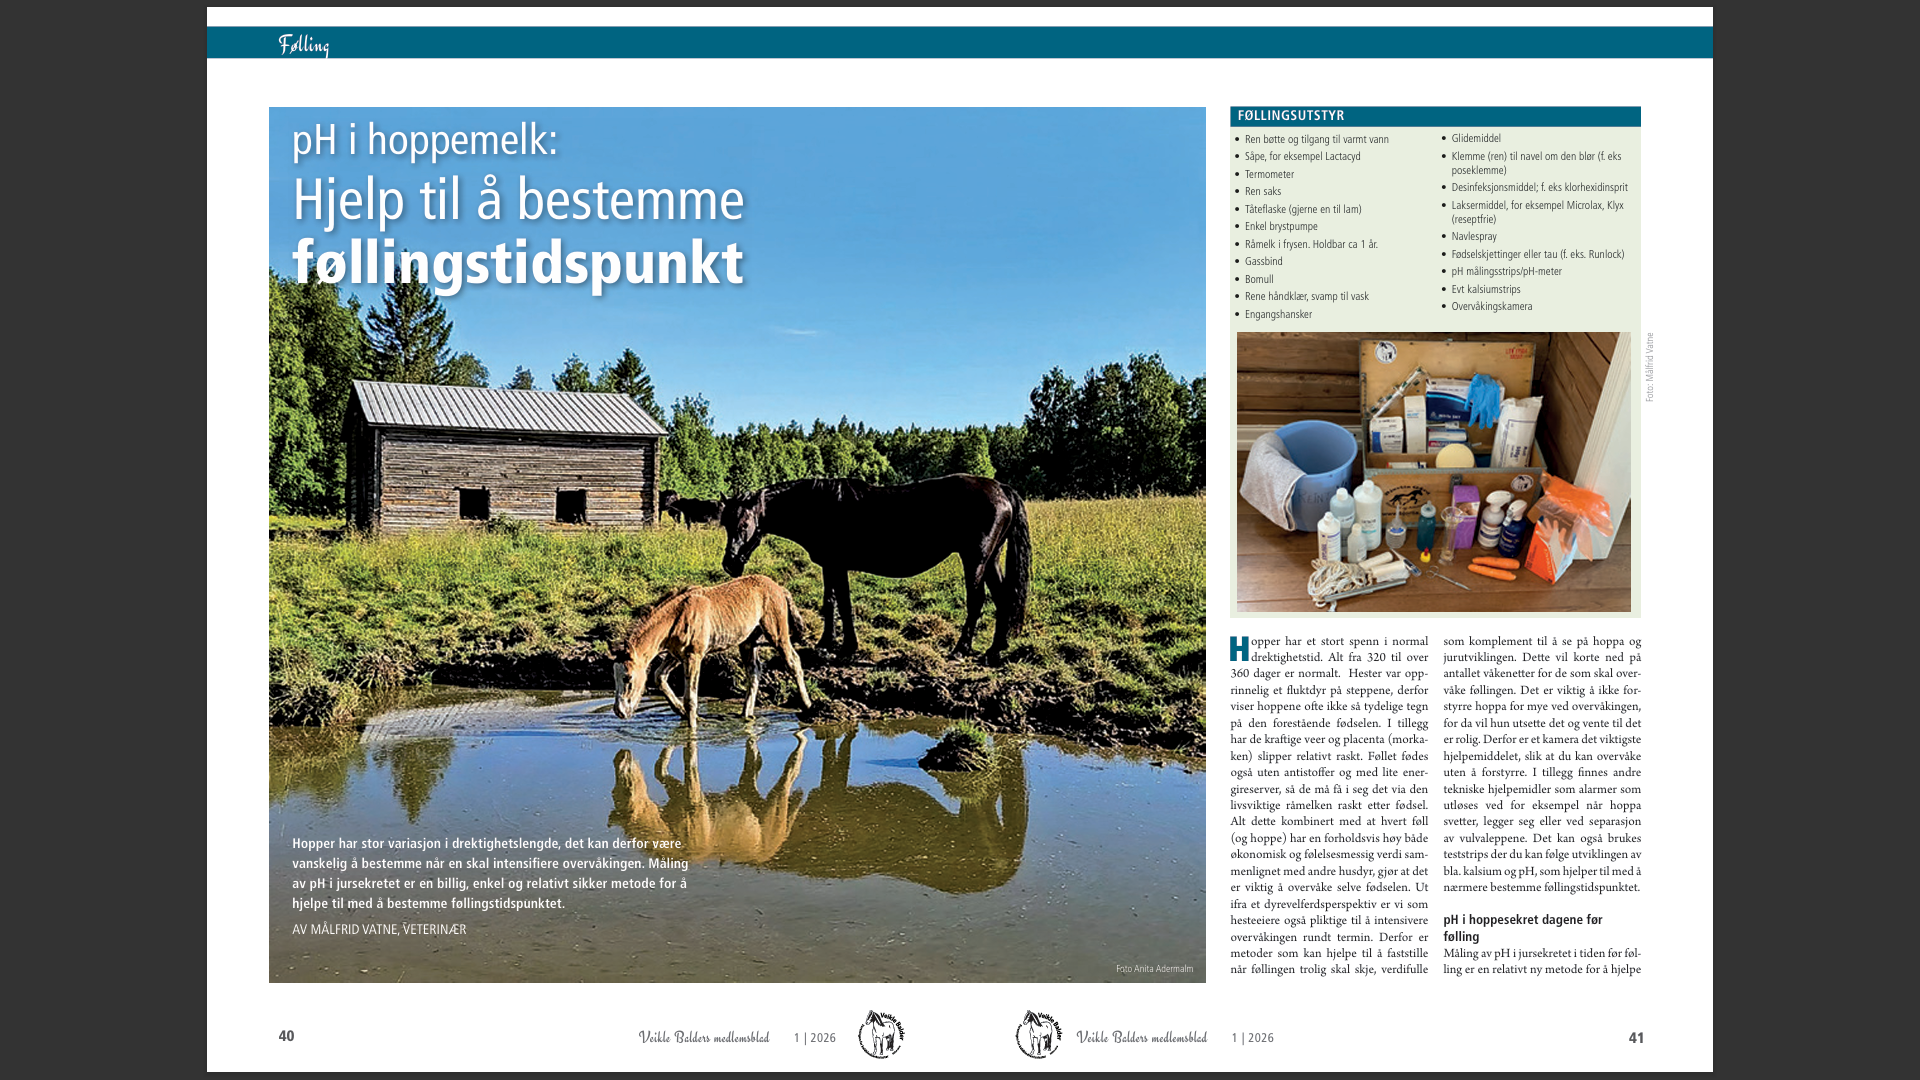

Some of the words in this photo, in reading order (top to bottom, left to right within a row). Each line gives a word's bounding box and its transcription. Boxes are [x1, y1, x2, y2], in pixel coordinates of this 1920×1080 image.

[279, 34, 329, 58] Følling
[1238, 110, 1344, 121] FØLLINGSUTSTYR
[294, 124, 334, 163] pH
[370, 122, 555, 163] hoppemelk:
[1452, 133, 1501, 142] Glidemiddel
[1245, 151, 1266, 163] Såpe,
[1270, 151, 1281, 160] for
[1284, 151, 1322, 162] eksempel
[1326, 151, 1360, 163] Lactacyd
[1245, 170, 1294, 178] Termometer
[1452, 165, 1506, 177] poseklemme)
[1246, 187, 1260, 195] Ren
[1264, 186, 1281, 195] saks
[1452, 182, 1538, 194] Desinfeksjonsmiddel;
[1541, 182, 1545, 191] f.
[1548, 182, 1562, 191] eks
[1565, 182, 1628, 193] klorhexidinsprit
[297, 176, 403, 232] Hjelp
[420, 176, 458, 219] til
[478, 174, 499, 219] å
[520, 176, 743, 219] bestemme
[1452, 200, 1508, 211] Laksermiddel,
[1511, 200, 1522, 209] for
[1525, 200, 1564, 212] eksempel
[1567, 200, 1604, 211] Microlax,
[1608, 200, 1624, 212] Klyx
[1452, 214, 1496, 226] (reseptfrie)
[1246, 221, 1266, 230] Enkel
[1270, 221, 1318, 233] brystpumpe
[1452, 231, 1497, 243] Navlespray
[293, 238, 742, 296] føllingstidspunkt
[1245, 256, 1282, 265] Gassbind
[1246, 274, 1273, 283] Bomull
[1452, 267, 1463, 278] pH
[1467, 266, 1562, 278] målingsstrips/pH-meter
[1452, 285, 1464, 293] Evt
[1468, 284, 1521, 296] kalsiumstrips
[1246, 292, 1265, 300] Rene
[1269, 291, 1308, 301] håndklær,
[1311, 294, 1338, 303] svamp
[1351, 291, 1369, 300] vask
[1452, 301, 1532, 313] Overvåkingskamera
[1246, 309, 1312, 321] Engangshansker
[1645, 332, 1654, 354] Vatne
[1645, 356, 1654, 382] Målfrid
[1645, 384, 1654, 402] Foto:
[1251, 652, 1323, 665] drektighetstid.
[1328, 652, 1343, 661] Alt
[1349, 652, 1362, 661] fra
[1367, 653, 1386, 662] 320
[1391, 652, 1401, 661] til
[1443, 652, 1516, 665] jurutviklingen.
[1523, 652, 1550, 661] Dette
[1556, 652, 1568, 661] vil
[1574, 652, 1599, 661] korte
[1606, 652, 1624, 661] ned
[1630, 653, 1641, 665] på
[1444, 784, 1484, 793] tekniske
[1488, 784, 1551, 797] hjelpemidler
[1579, 784, 1617, 793] alarmer
[1231, 800, 1280, 813] livsviktige
[1286, 800, 1332, 809] råmelken
[1338, 800, 1362, 809] raskt
[1396, 800, 1428, 809] fødsel.
[293, 838, 335, 851] Hopper
[340, 838, 357, 848] har
[362, 839, 384, 848] stor
[388, 838, 440, 851] variasjon
[453, 838, 560, 851] drektighetslengde,
[565, 838, 584, 848] det
[588, 838, 608, 848] kan
[613, 838, 648, 848] derfor
[1460, 833, 1527, 846] vulvaleppene.
[1533, 833, 1552, 842] Det
[1557, 833, 1575, 842] kan
[1581, 834, 1603, 846] også
[1608, 833, 1641, 842] brukes
[1231, 849, 1286, 858] økonomisk
[1289, 852, 1301, 862] og
[1305, 849, 1374, 862] følelsesmessig
[1377, 849, 1402, 858] verdi
[1490, 882, 1541, 891] bestemme
[1545, 882, 1640, 895] føllingstidspunktet.
[293, 898, 327, 911] hjelpe
[332, 898, 343, 908] til
[348, 898, 372, 908] med
[377, 898, 383, 908] å
[388, 898, 447, 908] bestemme
[452, 898, 564, 911] føllingstidspunktet.
[1231, 899, 1247, 908] ifra
[1264, 899, 1377, 912] dyrevelferdsperspektiv
[1394, 900, 1403, 908] vi
[1444, 914, 1458, 927] pH
[1469, 914, 1538, 927] hoppesekret
[1542, 914, 1583, 927] dagene
[1586, 914, 1603, 924] før
[293, 924, 307, 934] AV
[312, 921, 359, 934] MÅLFRID
[363, 924, 399, 935] VATNE,
[403, 924, 466, 934] VETERINÆR
[1231, 932, 1297, 945] overvåkingen
[1303, 932, 1331, 941] rundt
[1337, 933, 1373, 941] termin.
[1379, 932, 1413, 941] Derfor
[1443, 931, 1479, 944] følling
[1231, 965, 1247, 973] når
[1252, 964, 1295, 977] føllingen
[1300, 964, 1326, 977] trolig
[1331, 964, 1350, 973] skal
[1355, 964, 1376, 977] skje,
[1381, 964, 1428, 973] verdifulle
[1038, 1012, 1054, 1023] Veikle
[1053, 1021, 1063, 1041] Balder
[279, 1030, 294, 1041] 40
[639, 1031, 670, 1043] Veikle
[674, 1030, 710, 1043] Balders
[714, 1031, 769, 1042] medlemsblad
[811, 1033, 836, 1042] 2026
[1077, 1031, 1108, 1043] Veikle
[1112, 1030, 1148, 1043] Balders
[1152, 1031, 1207, 1042] medlemsblad
[1248, 1033, 1274, 1042] 2026
[1629, 1032, 1643, 1043] 41
